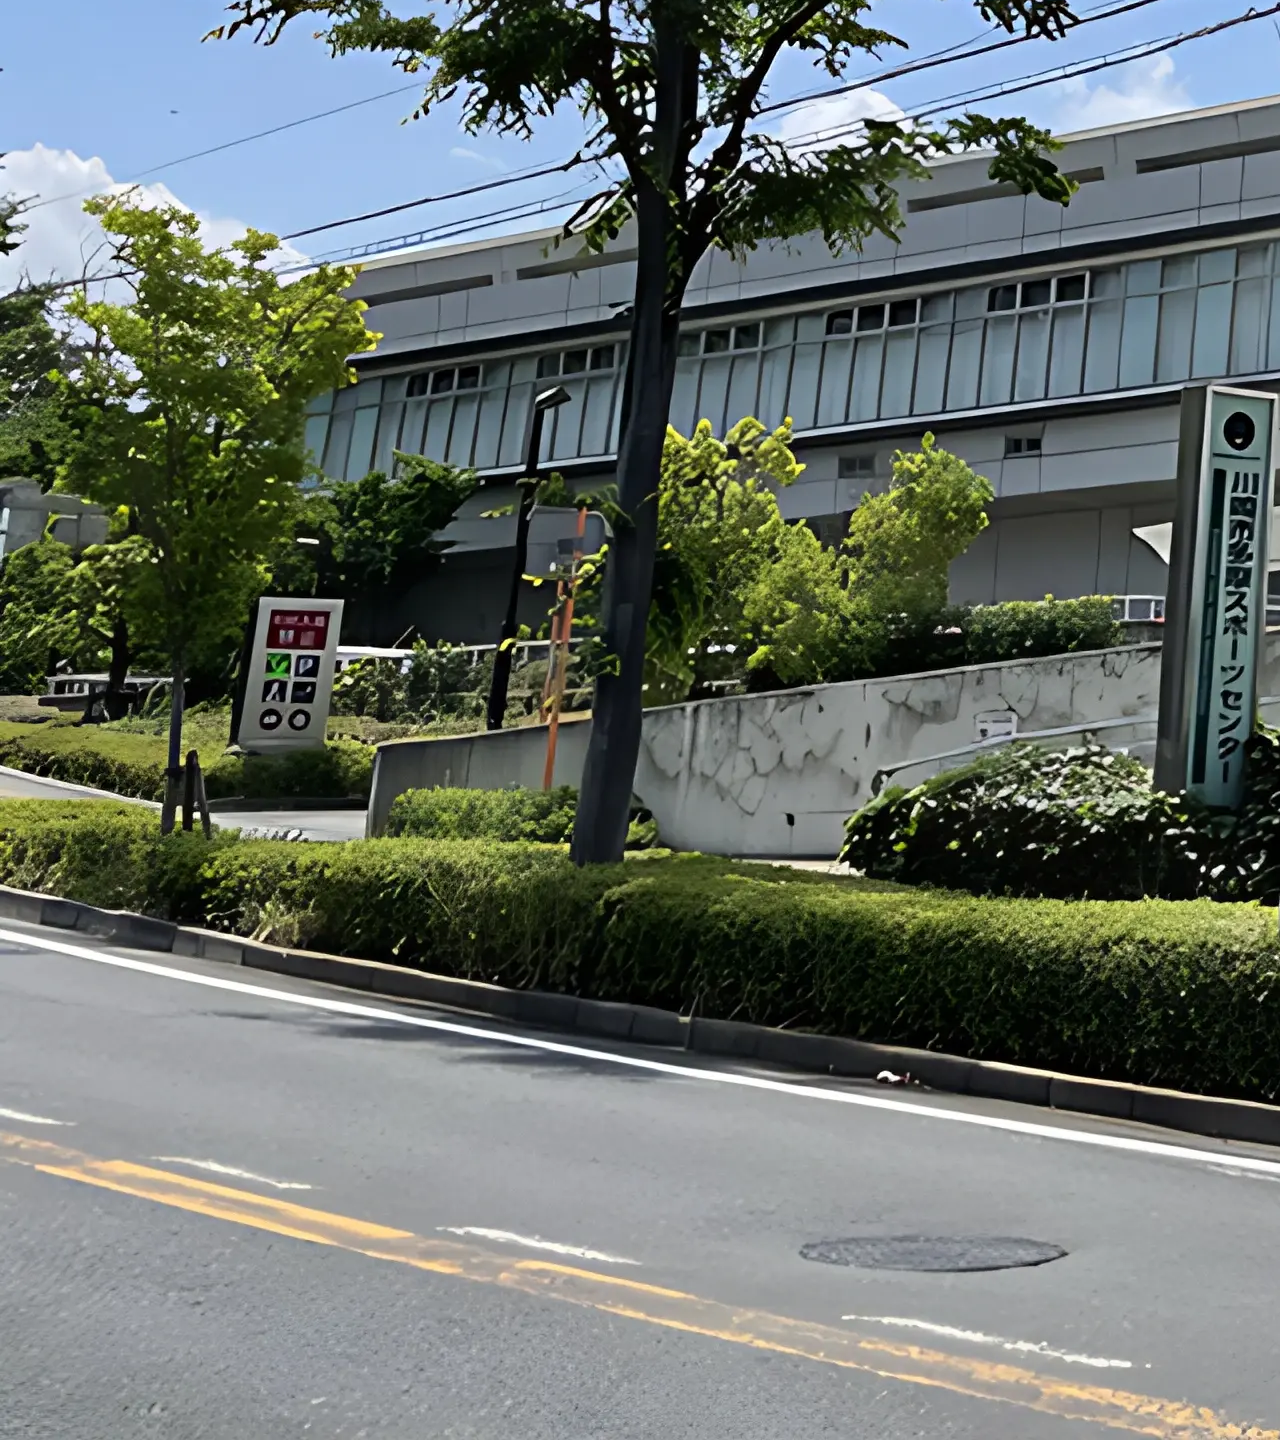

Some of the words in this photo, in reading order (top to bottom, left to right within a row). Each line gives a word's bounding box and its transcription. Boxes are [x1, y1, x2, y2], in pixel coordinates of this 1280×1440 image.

[1218, 471, 1260, 783] 川スポーツセンター
